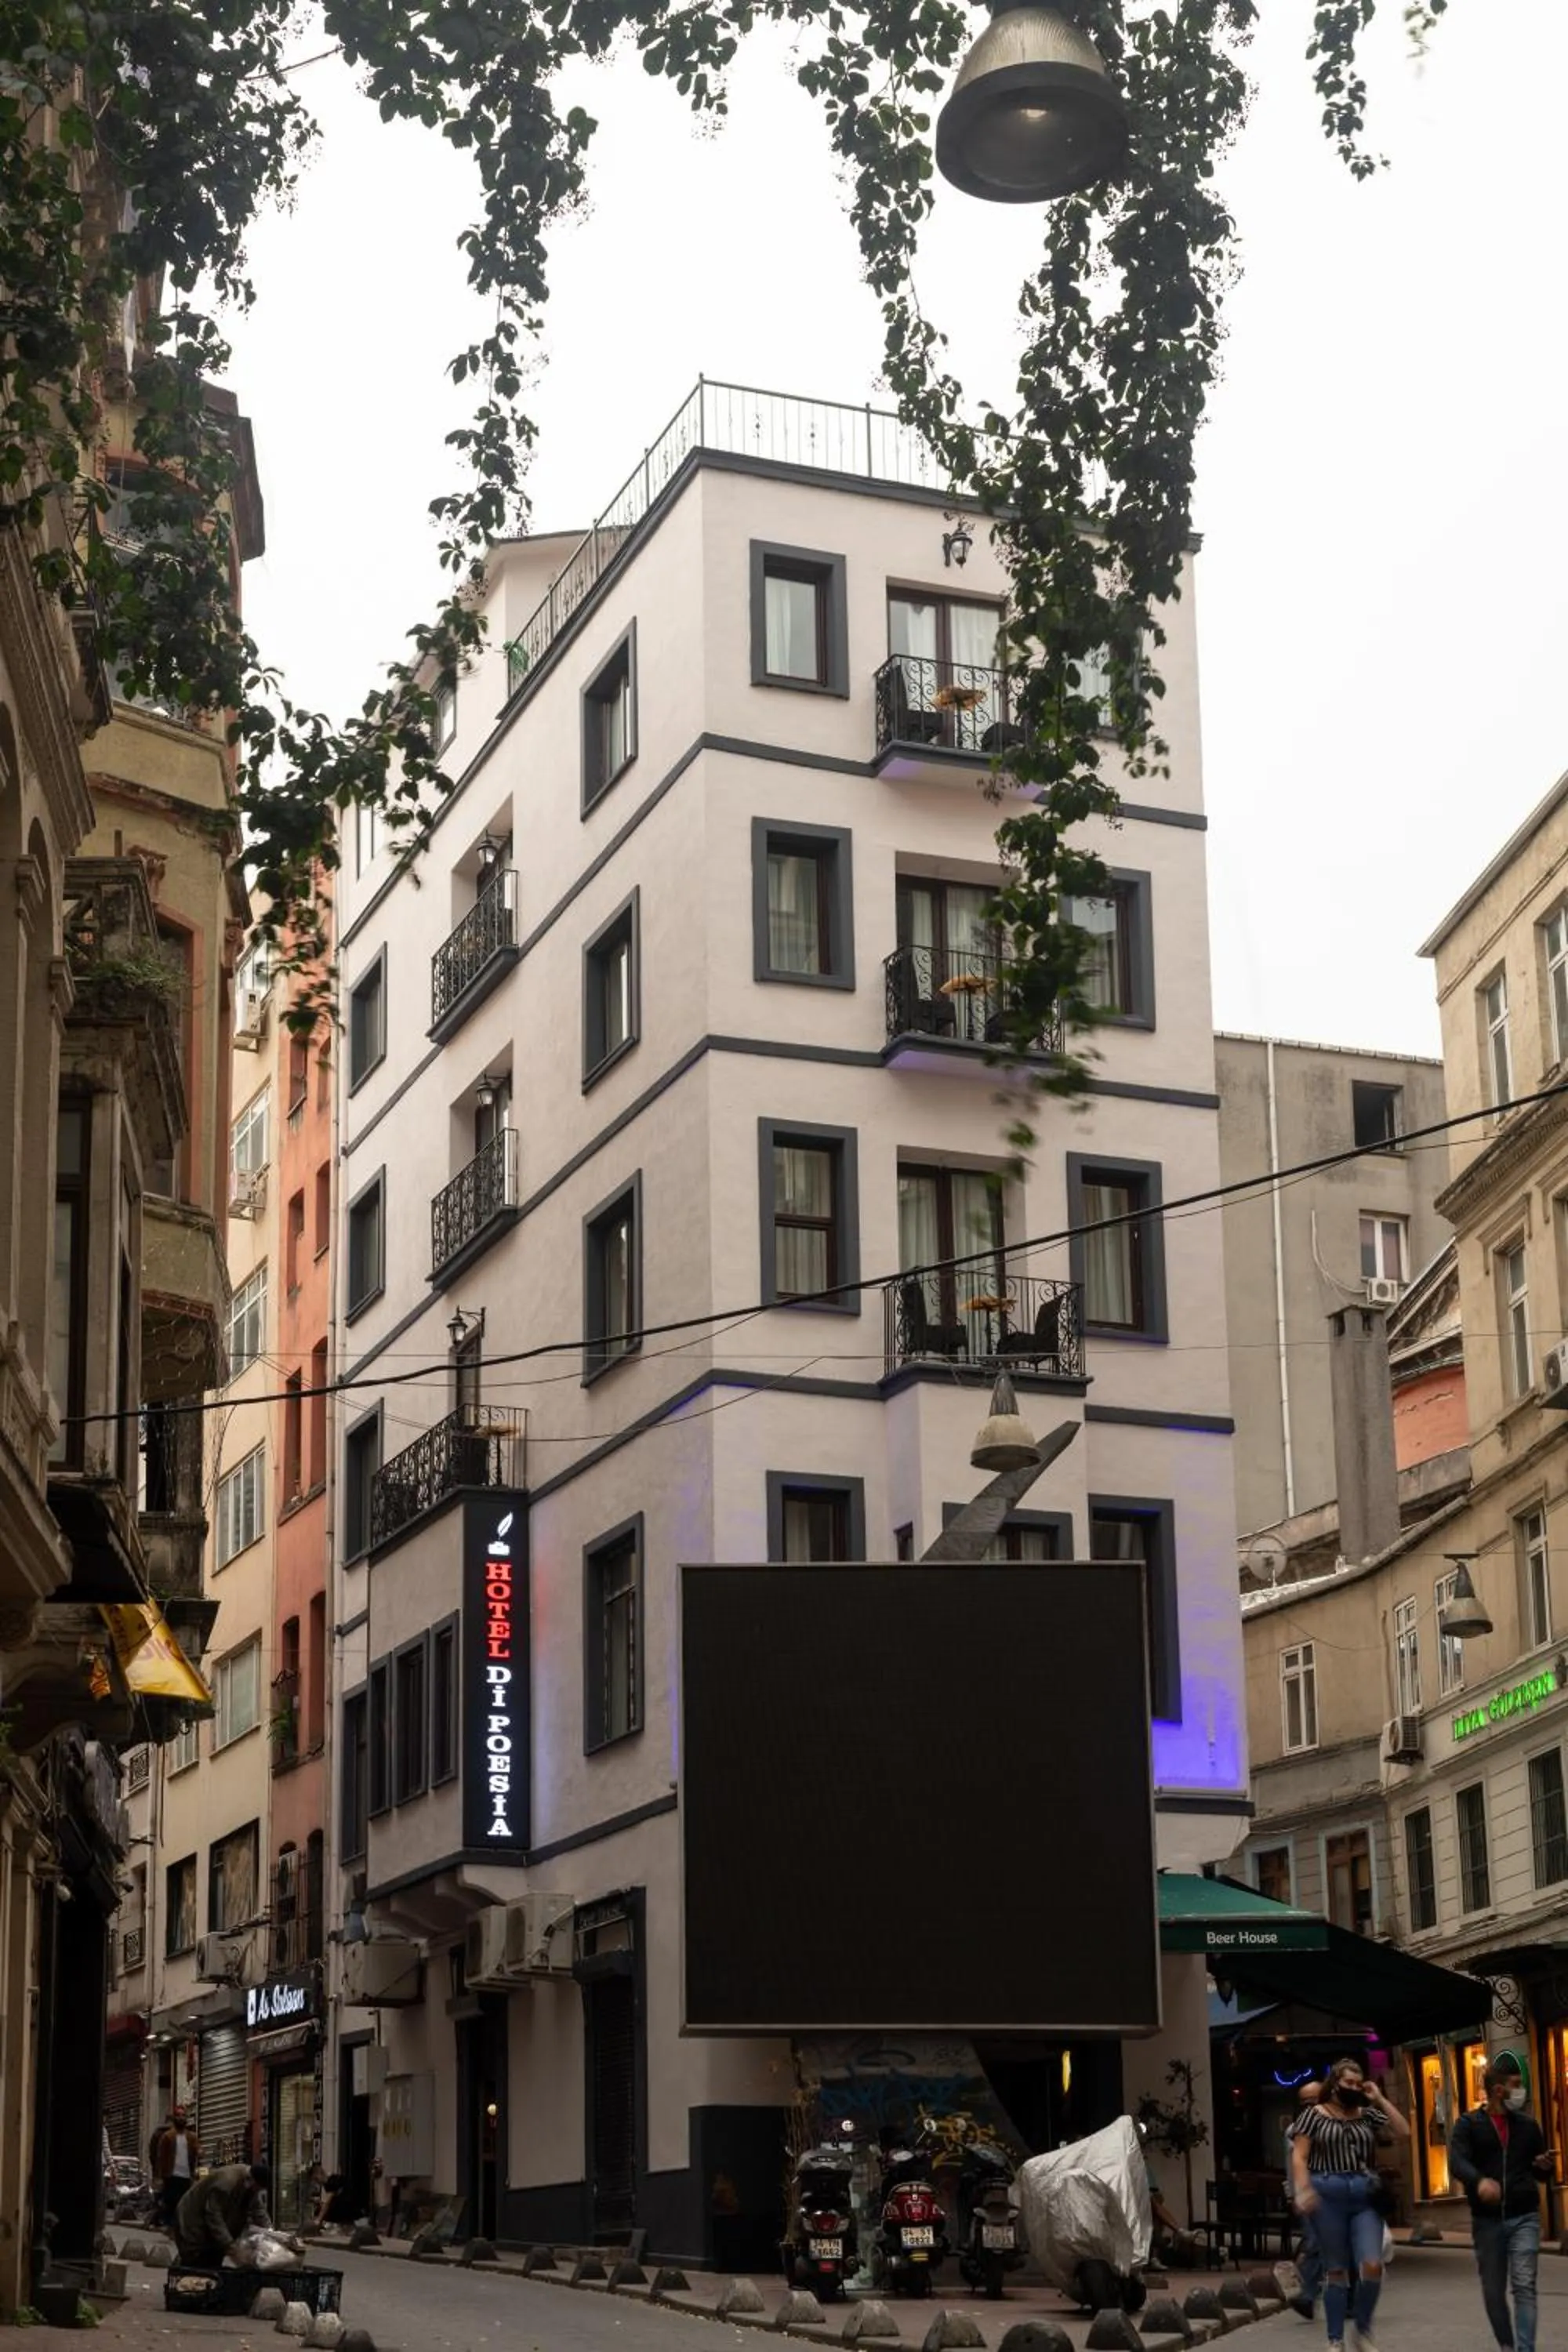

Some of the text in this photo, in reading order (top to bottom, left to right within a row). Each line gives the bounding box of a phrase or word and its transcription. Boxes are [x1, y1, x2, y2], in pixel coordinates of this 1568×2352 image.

[485, 1563, 512, 1657] HOTEL
[1207, 1931, 1278, 1944] Beer House
